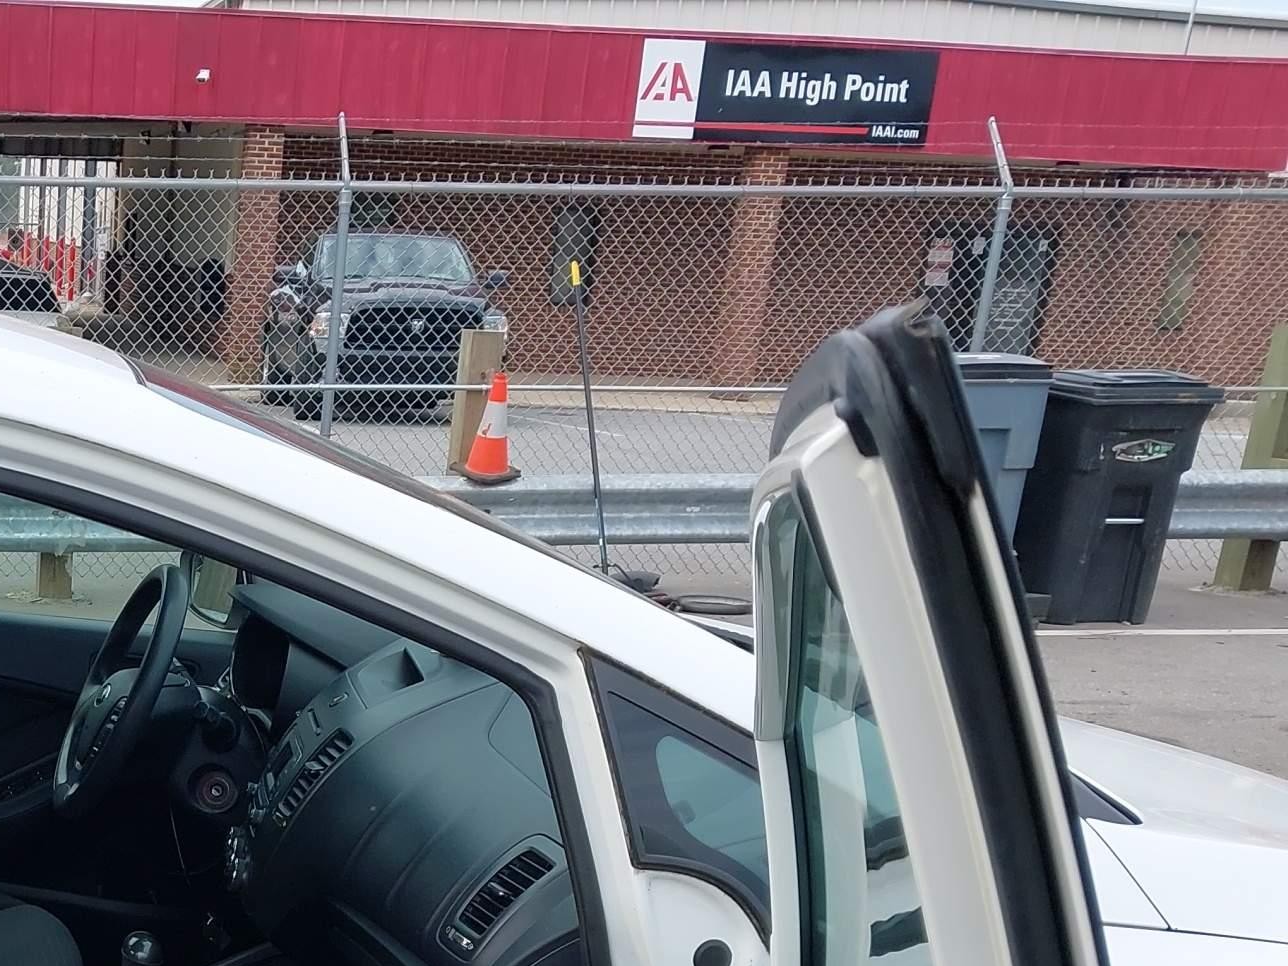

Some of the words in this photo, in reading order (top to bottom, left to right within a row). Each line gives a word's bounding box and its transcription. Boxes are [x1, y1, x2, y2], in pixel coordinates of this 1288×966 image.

[725, 69, 772, 98] IAA
[779, 71, 836, 106] High
[844, 74, 910, 103] Point
[871, 125, 920, 140] IAAI.com
